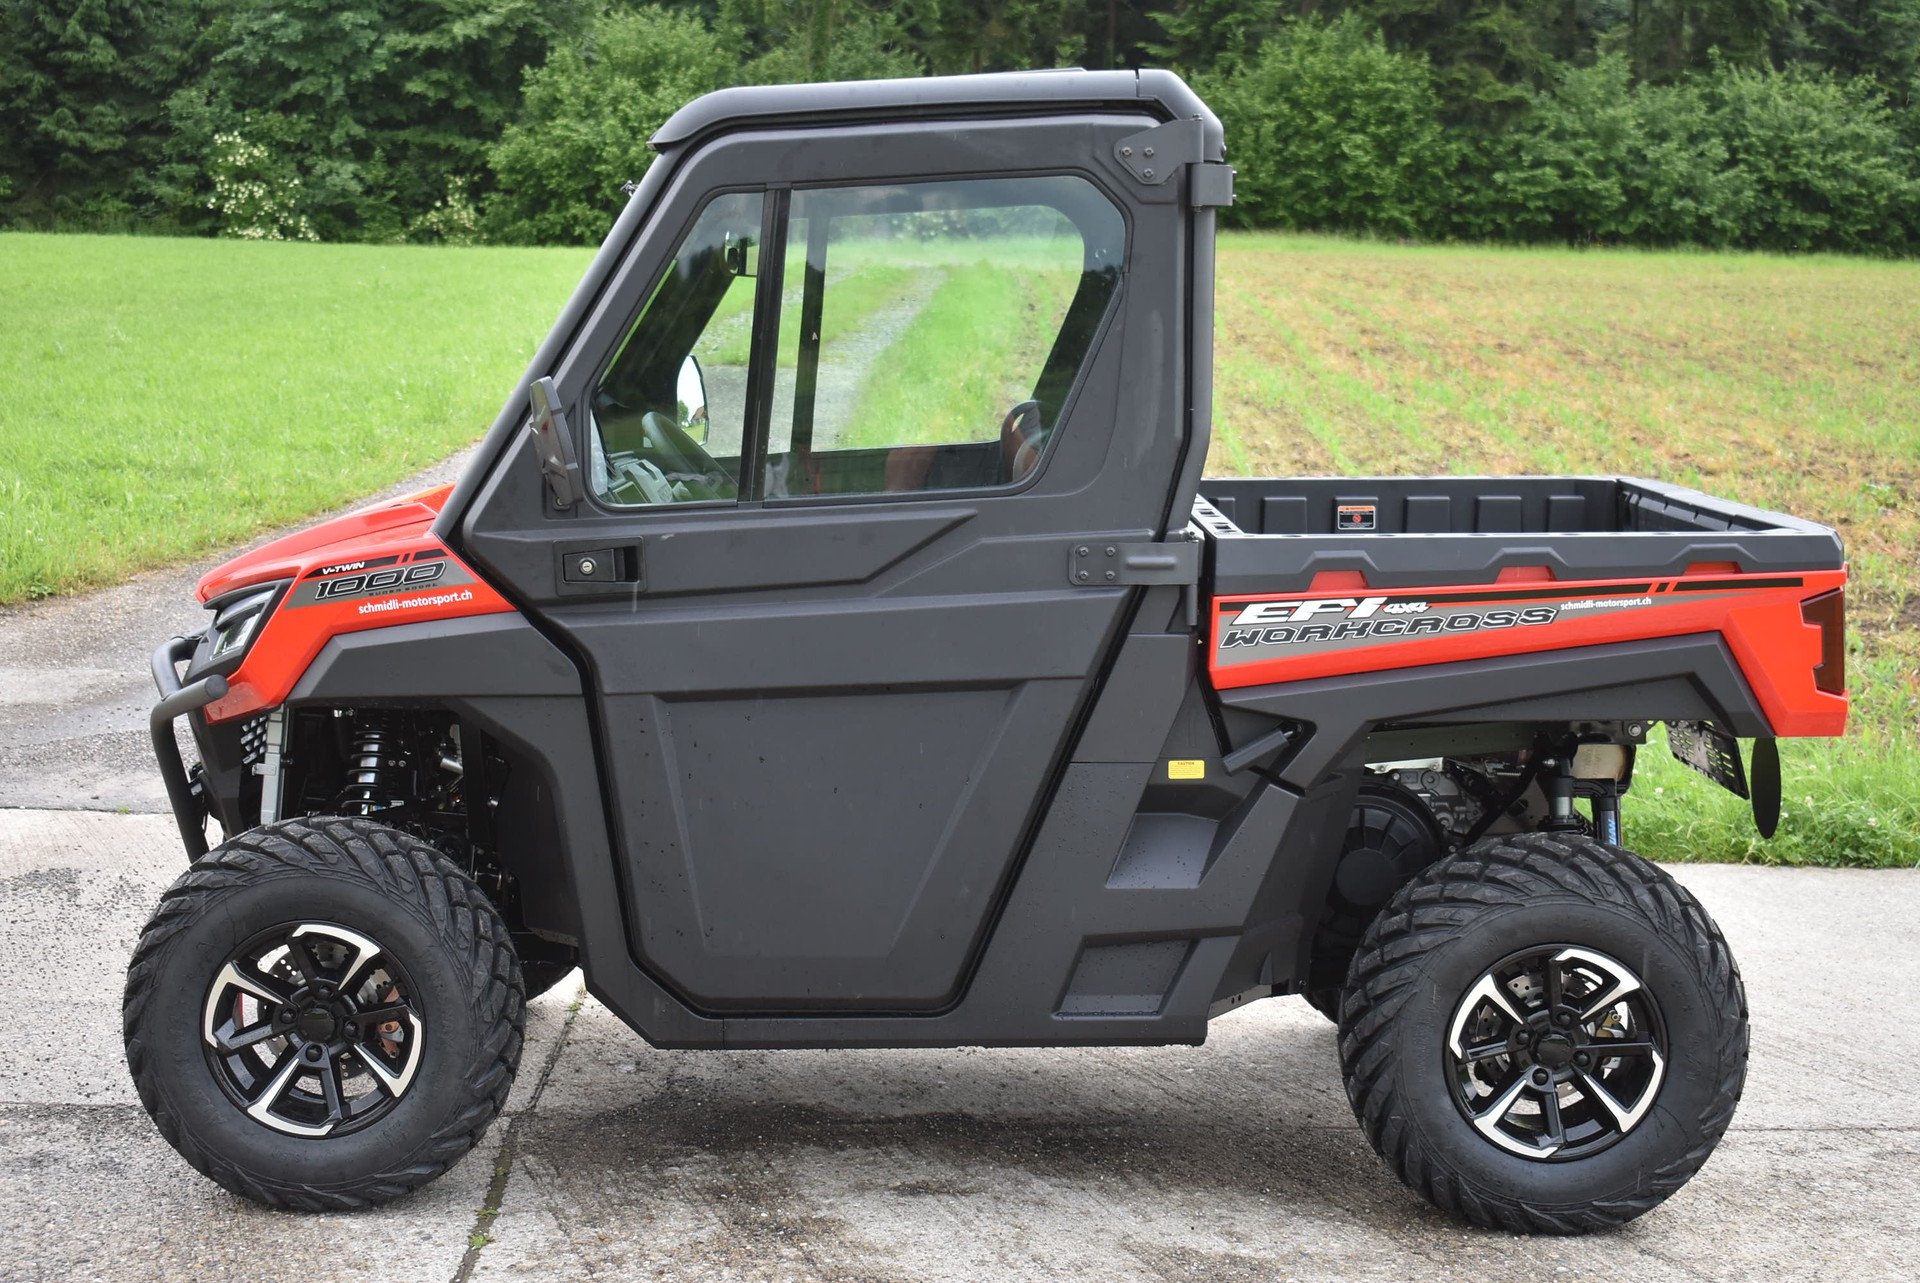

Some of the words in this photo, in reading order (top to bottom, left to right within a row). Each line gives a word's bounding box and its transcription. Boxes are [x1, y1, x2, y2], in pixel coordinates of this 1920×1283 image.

[315, 560, 447, 600] 1000
[322, 561, 365, 575] V-TWIN
[358, 590, 472, 614] schmidli-motorsport.ch
[1230, 597, 1388, 625] EFI
[1560, 597, 1652, 611] schmidli-motorsport.ch
[1219, 607, 1559, 649] WORKCROSS
